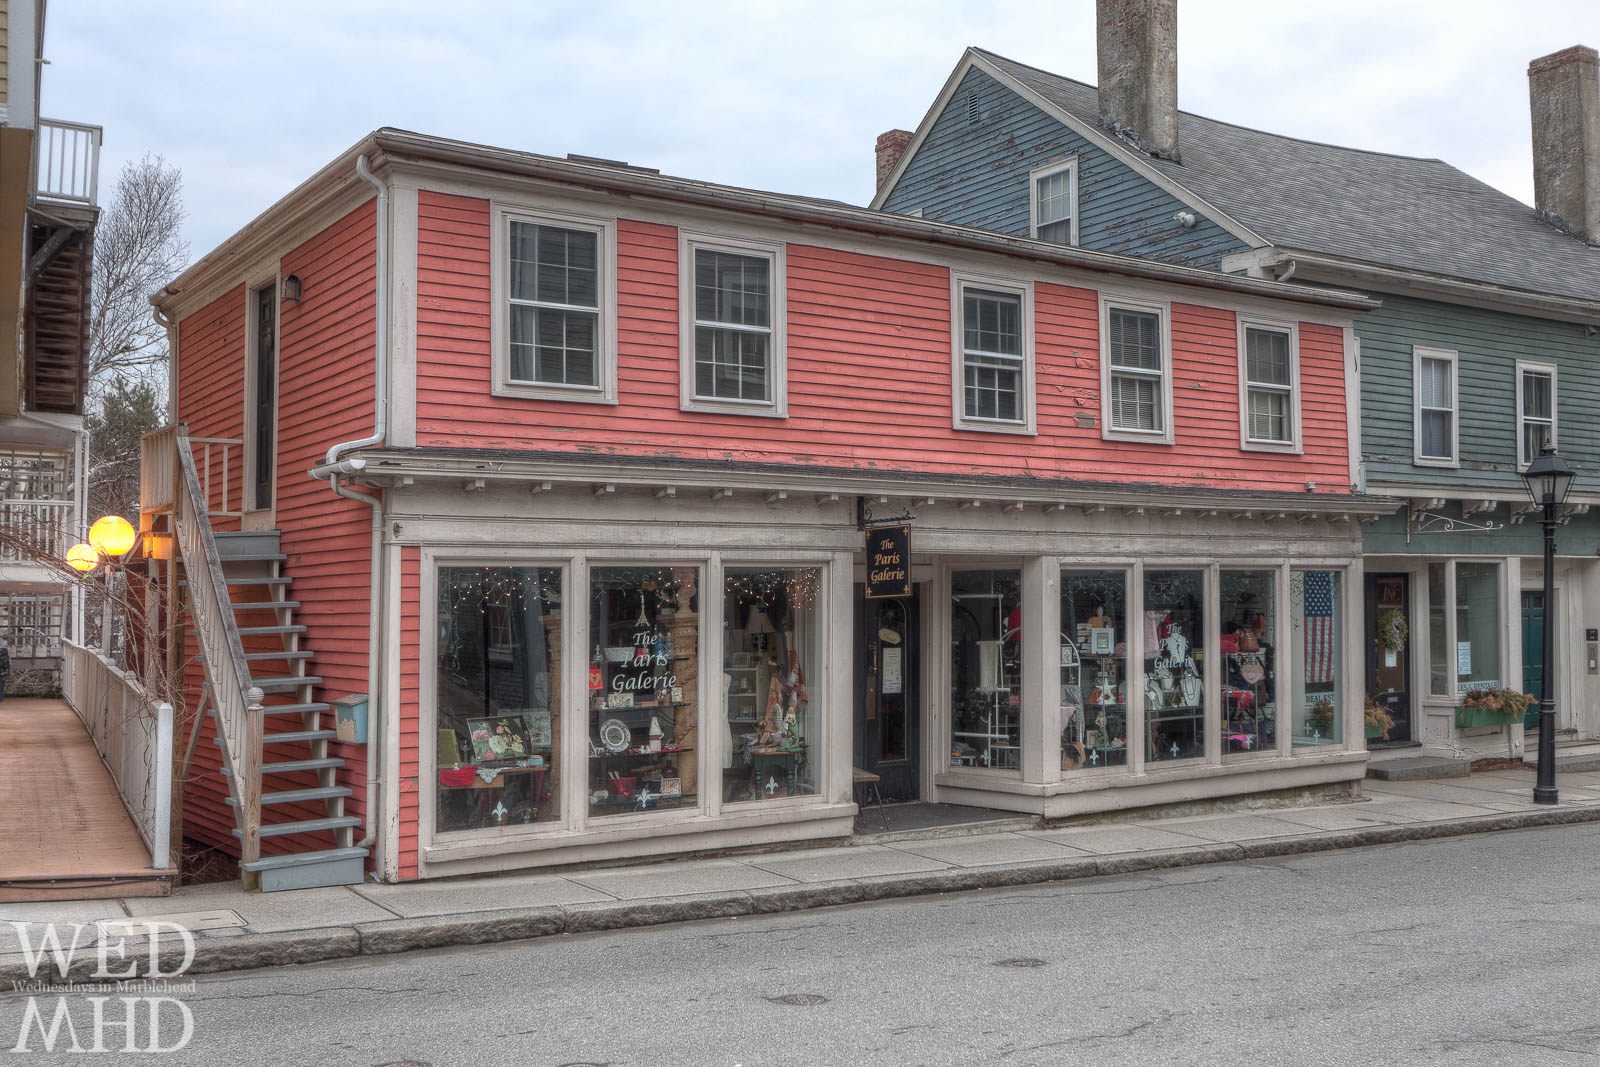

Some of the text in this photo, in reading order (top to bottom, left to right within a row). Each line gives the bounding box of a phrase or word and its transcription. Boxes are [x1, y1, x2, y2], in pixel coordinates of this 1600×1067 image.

[880, 539, 894, 549] The
[874, 552, 901, 565] Paris
[871, 567, 904, 584] Galerie
[1166, 623, 1182, 634] The
[633, 630, 657, 645] The
[621, 649, 669, 667] Paris
[612, 671, 677, 694] Galerie
